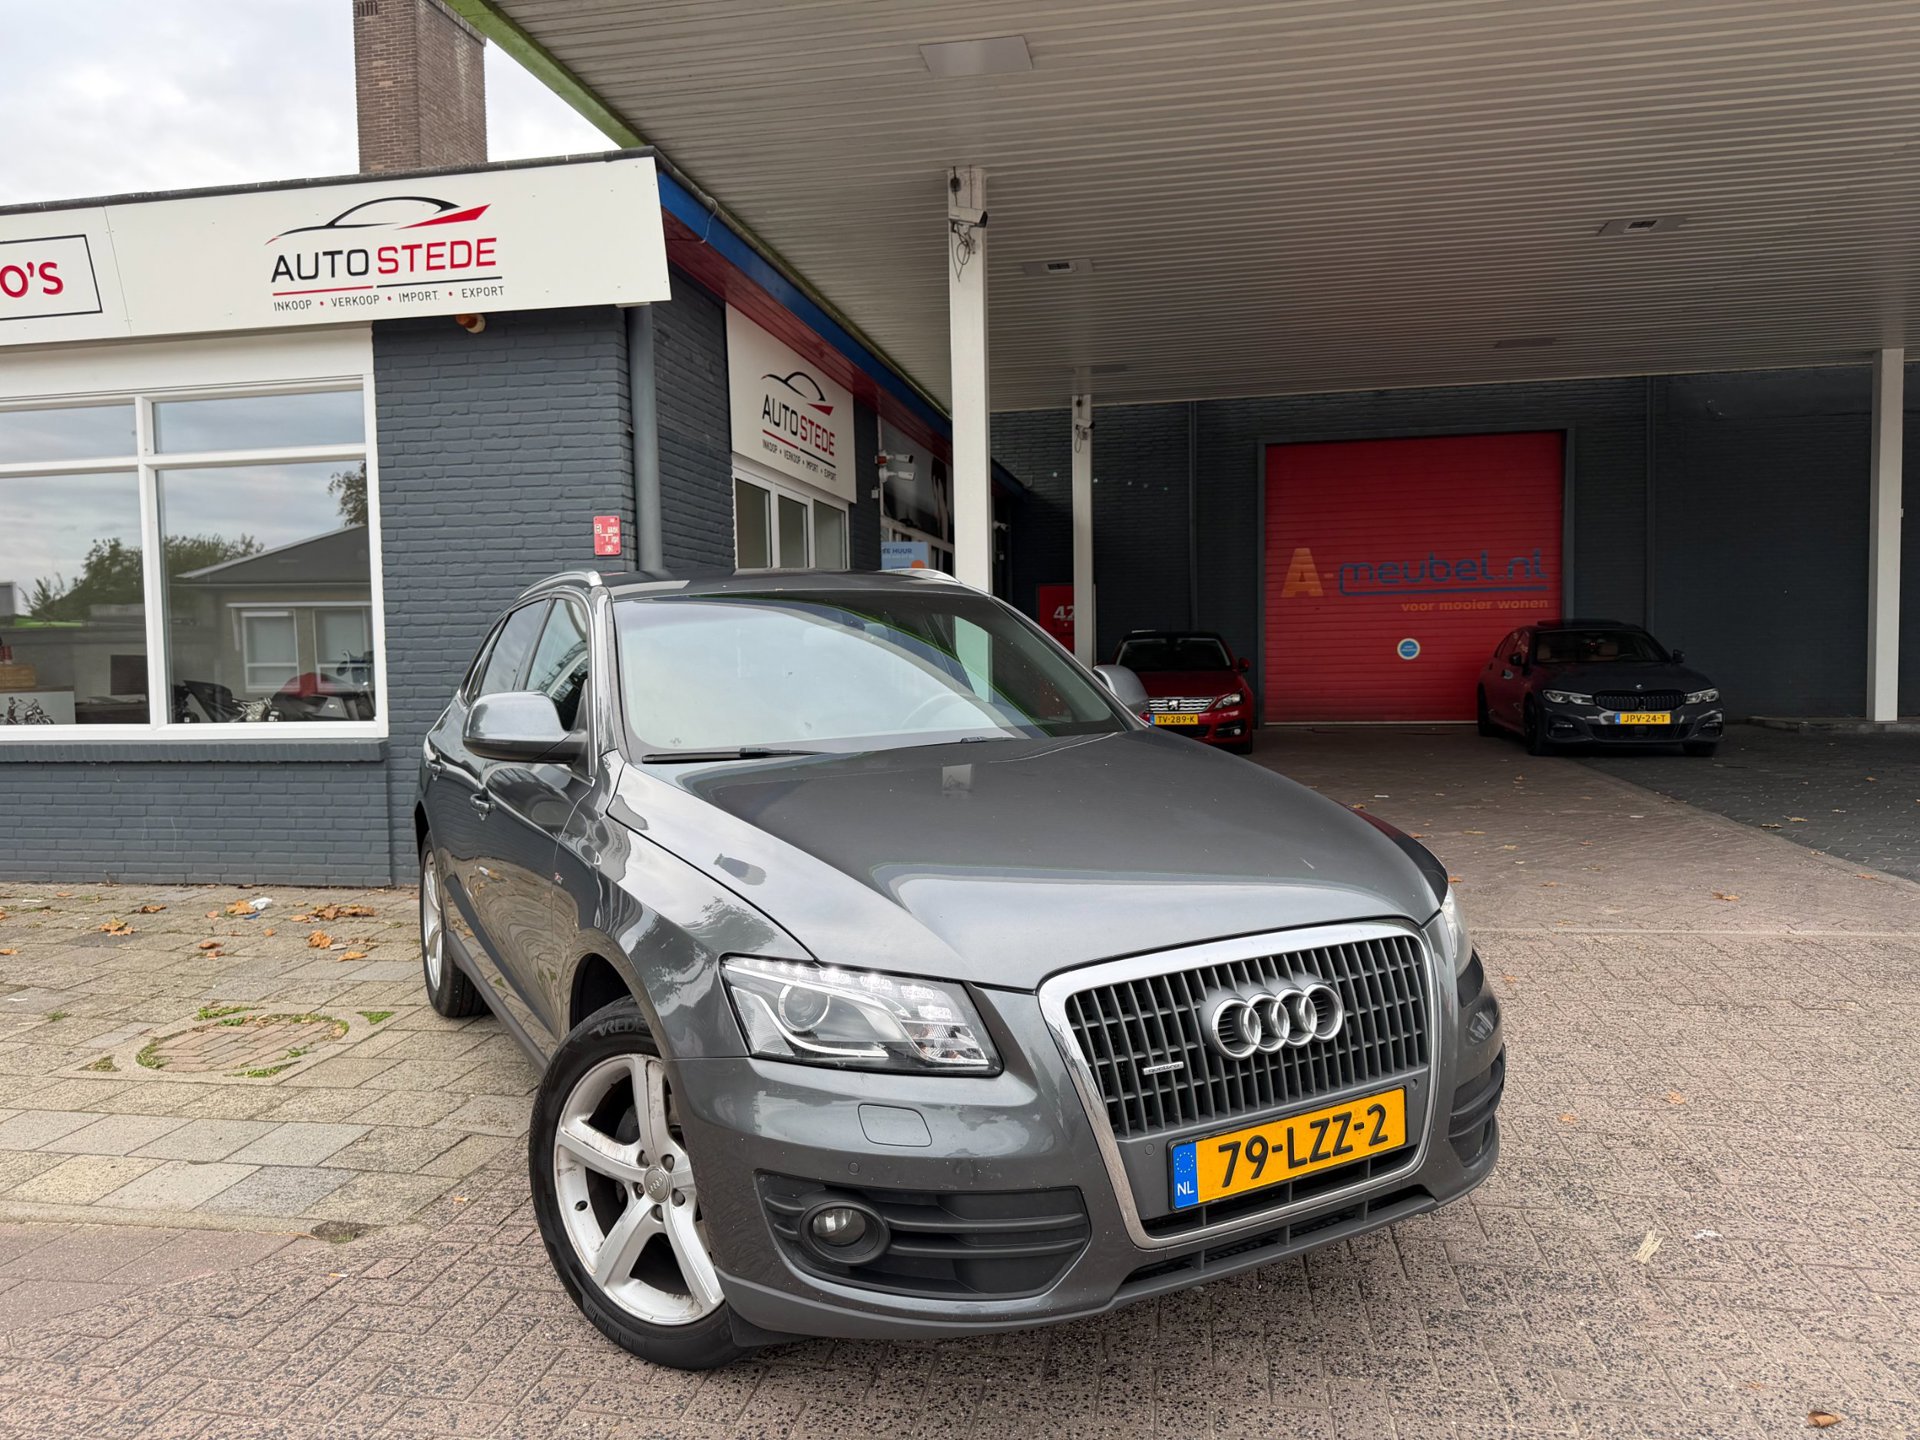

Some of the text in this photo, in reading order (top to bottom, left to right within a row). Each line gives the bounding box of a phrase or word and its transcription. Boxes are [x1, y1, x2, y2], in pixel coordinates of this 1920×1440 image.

[273, 285, 504, 312] INKOOP VERKOOP IMPORT EXPORT
[1401, 599, 1549, 612] voor mooier wonen
[1157, 715, 1195, 724] TV-289-K
[1624, 714, 1666, 723] JPV-24-T
[1218, 1103, 1389, 1188] 79-LZZ-2
[1177, 1180, 1195, 1197] NL
